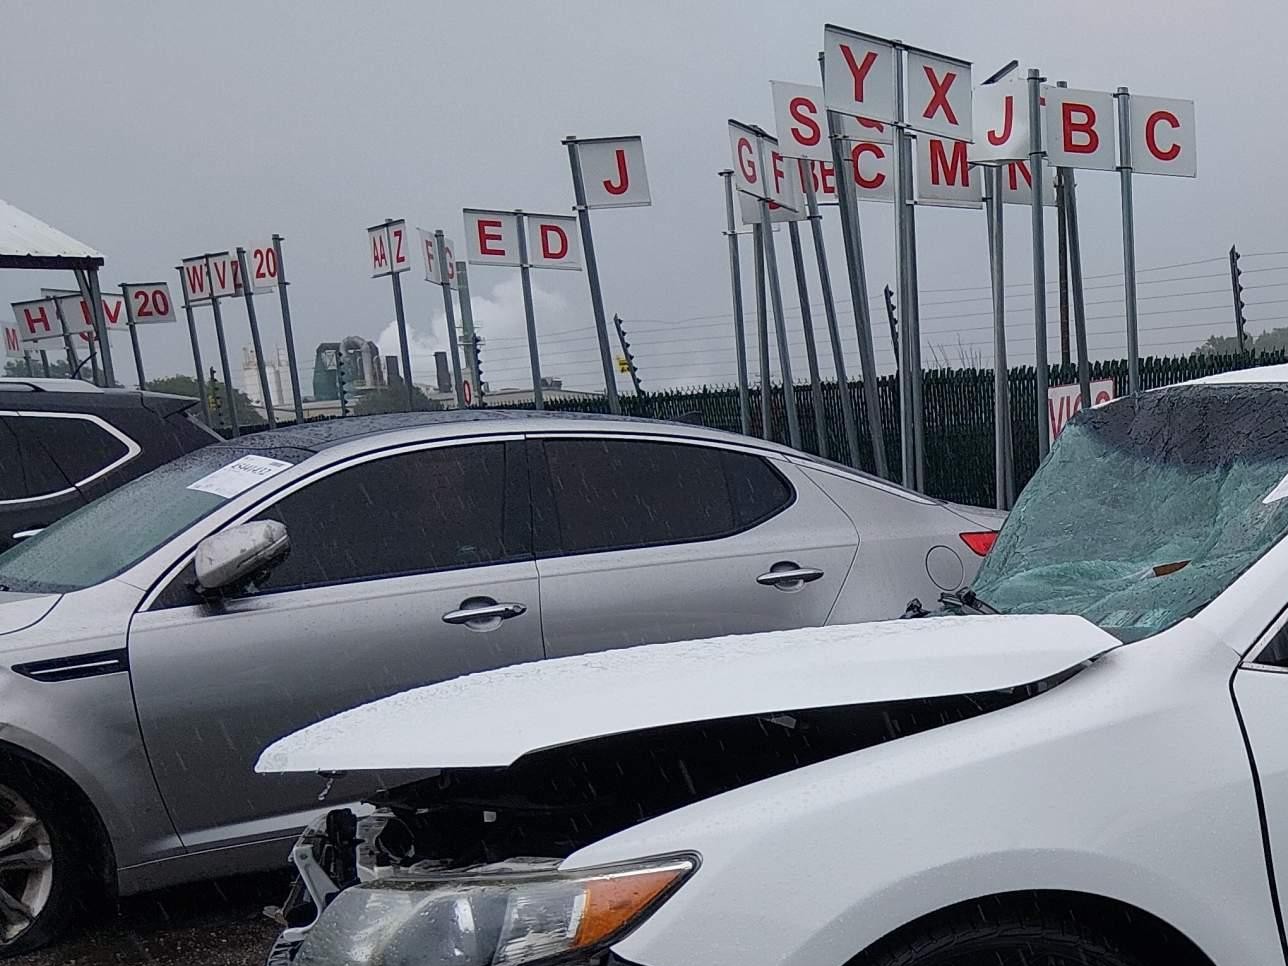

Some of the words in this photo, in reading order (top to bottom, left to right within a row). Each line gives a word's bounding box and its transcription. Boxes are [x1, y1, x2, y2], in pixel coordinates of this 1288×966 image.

[839, 43, 878, 103] Y
[923, 65, 959, 126] X
[788, 96, 821, 147] S
[987, 95, 1014, 147] J
[1060, 101, 1100, 154] B
[1144, 110, 1182, 162] C
[602, 149, 630, 196] J
[737, 137, 758, 184] G
[851, 142, 886, 189] C
[928, 138, 970, 187] M
[372, 236, 388, 269] AA
[392, 229, 406, 264] Z
[424, 238, 436, 273] F
[476, 218, 506, 257] E
[539, 223, 570, 260] D
[185, 263, 205, 295] W
[213, 259, 227, 290] V
[253, 247, 278, 280] 20
[23, 306, 52, 335] H
[133, 289, 171, 318] 20
[4, 326, 21, 352] M
